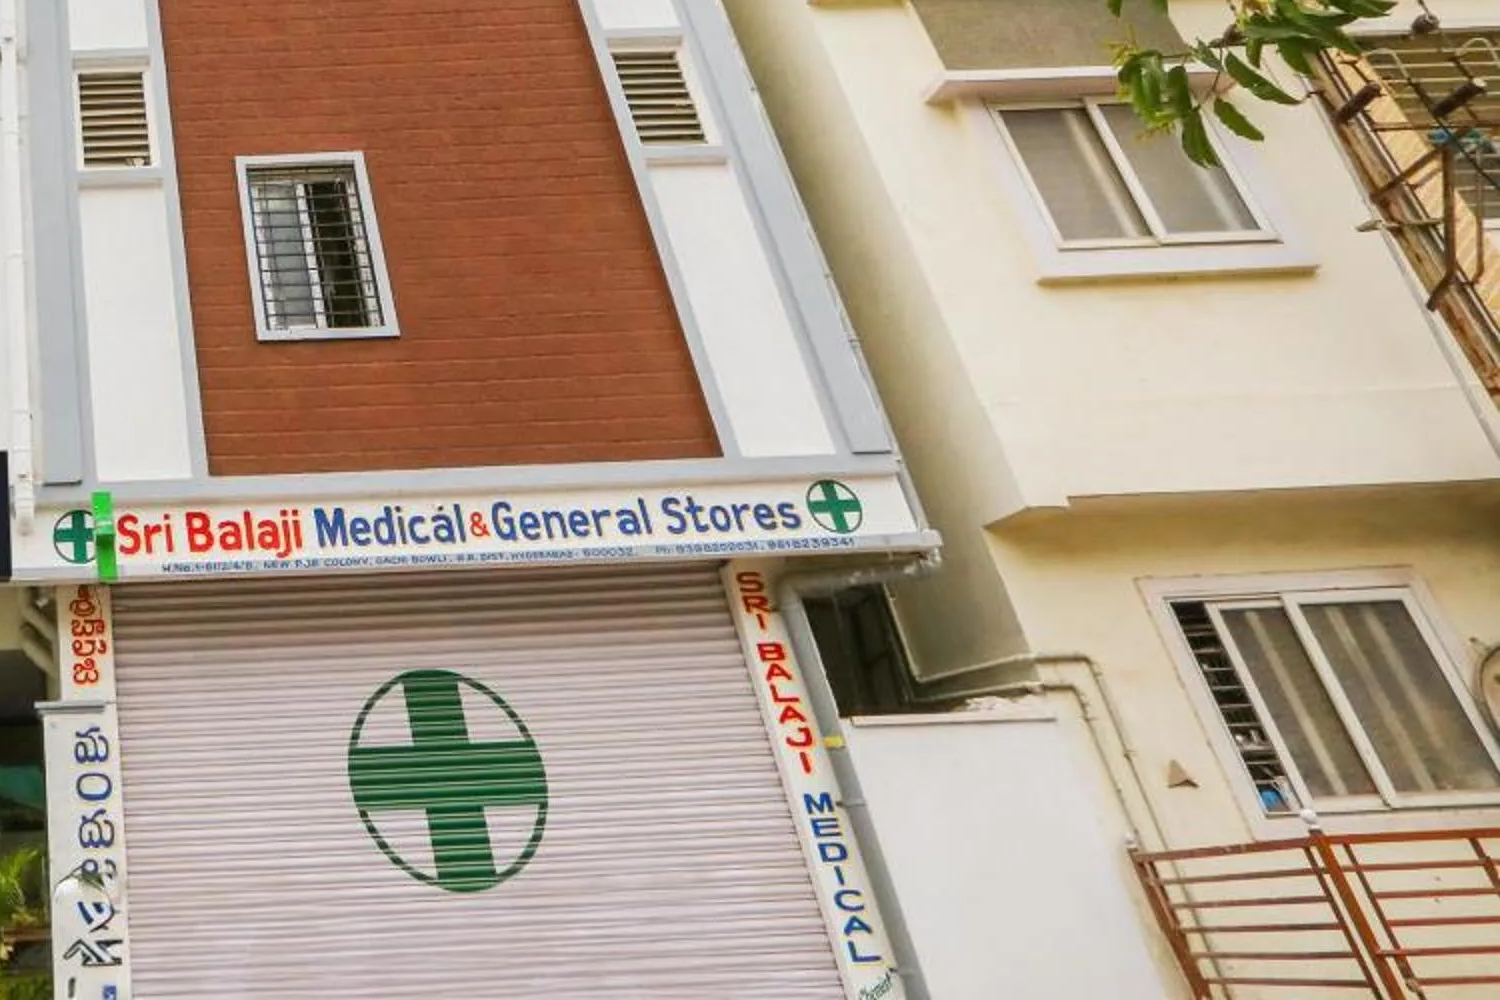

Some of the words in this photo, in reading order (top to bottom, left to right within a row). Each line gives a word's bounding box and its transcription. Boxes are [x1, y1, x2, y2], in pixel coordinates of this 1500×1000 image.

[117, 513, 174, 555] Sri
[185, 509, 303, 558] Balaji
[491, 499, 653, 543] General
[661, 496, 802, 535] Stores
[736, 571, 776, 630] SRI
[756, 642, 814, 775] BALAJI
[803, 792, 882, 963] MEDICAL
